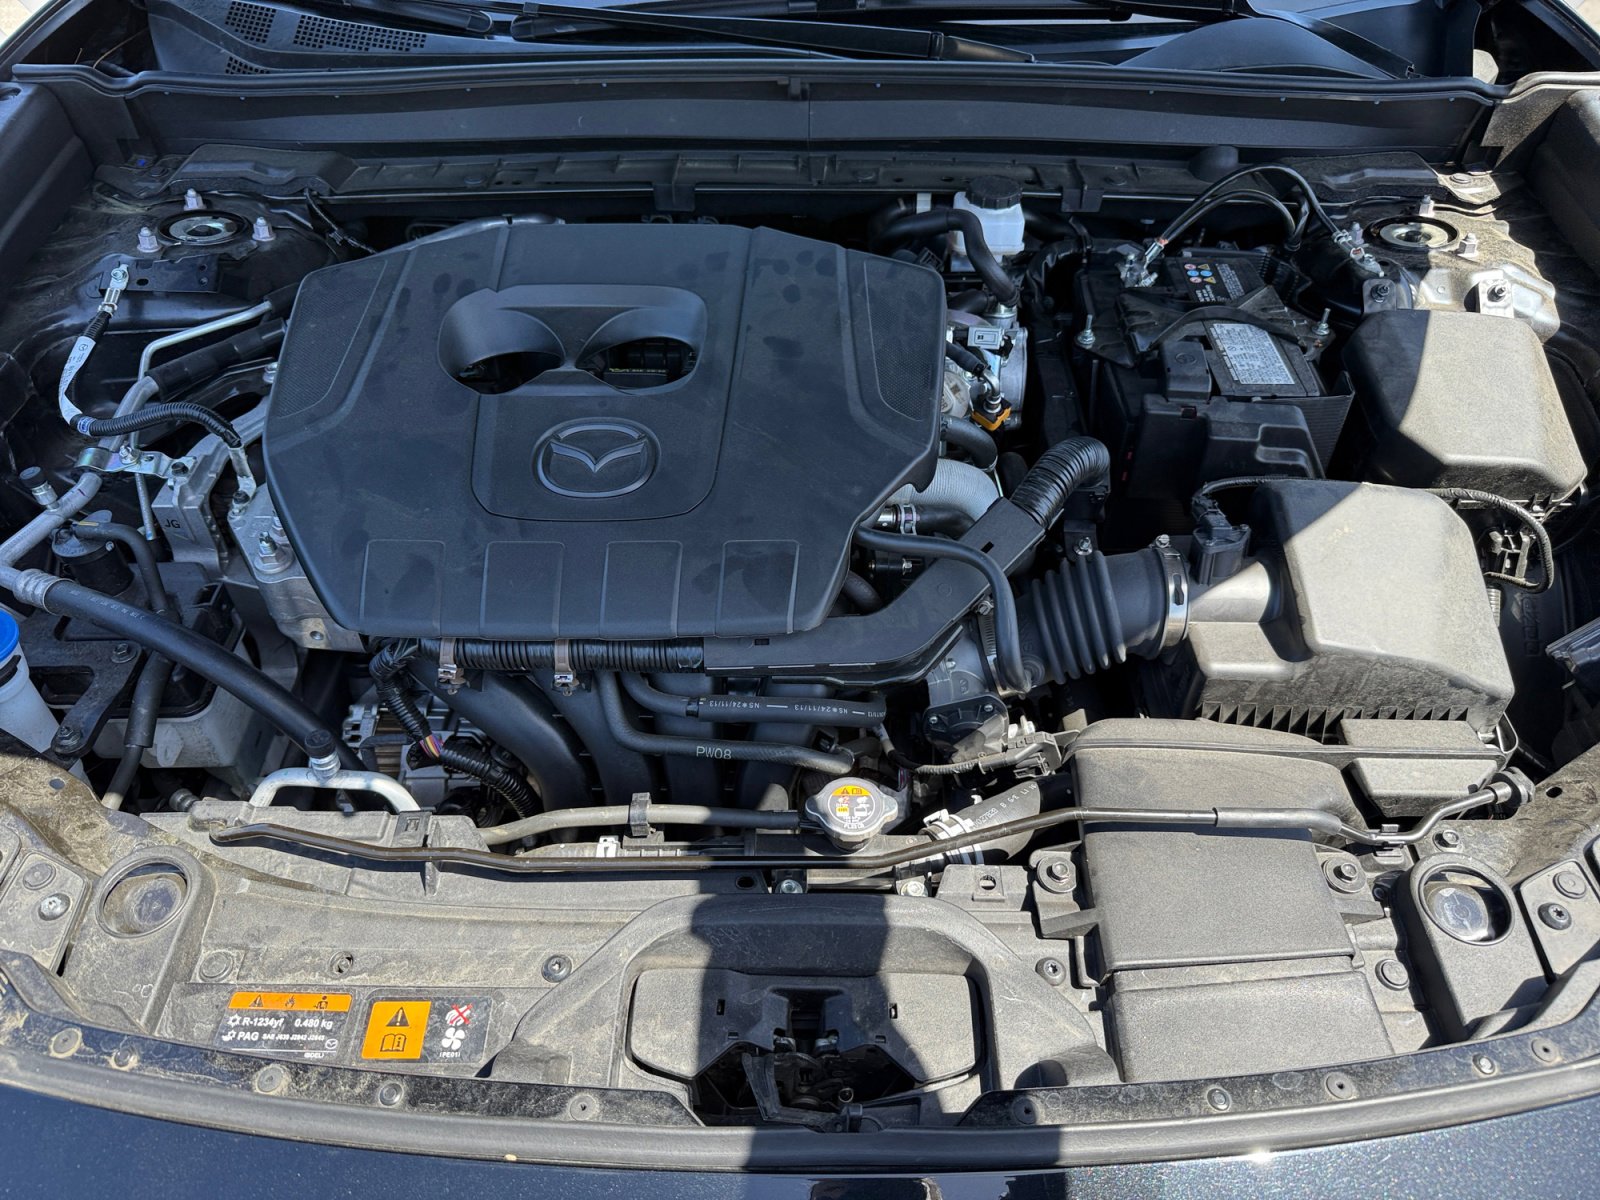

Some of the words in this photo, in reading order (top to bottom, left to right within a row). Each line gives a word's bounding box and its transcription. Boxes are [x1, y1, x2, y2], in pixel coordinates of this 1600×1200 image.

[165, 519, 181, 528] JG
[696, 745, 732, 760] PW08
[241, 1017, 285, 1028] R-1234yf
[294, 1018, 320, 1028] 0.480
[321, 1019, 333, 1030] kg
[237, 1031, 259, 1041] PAG
